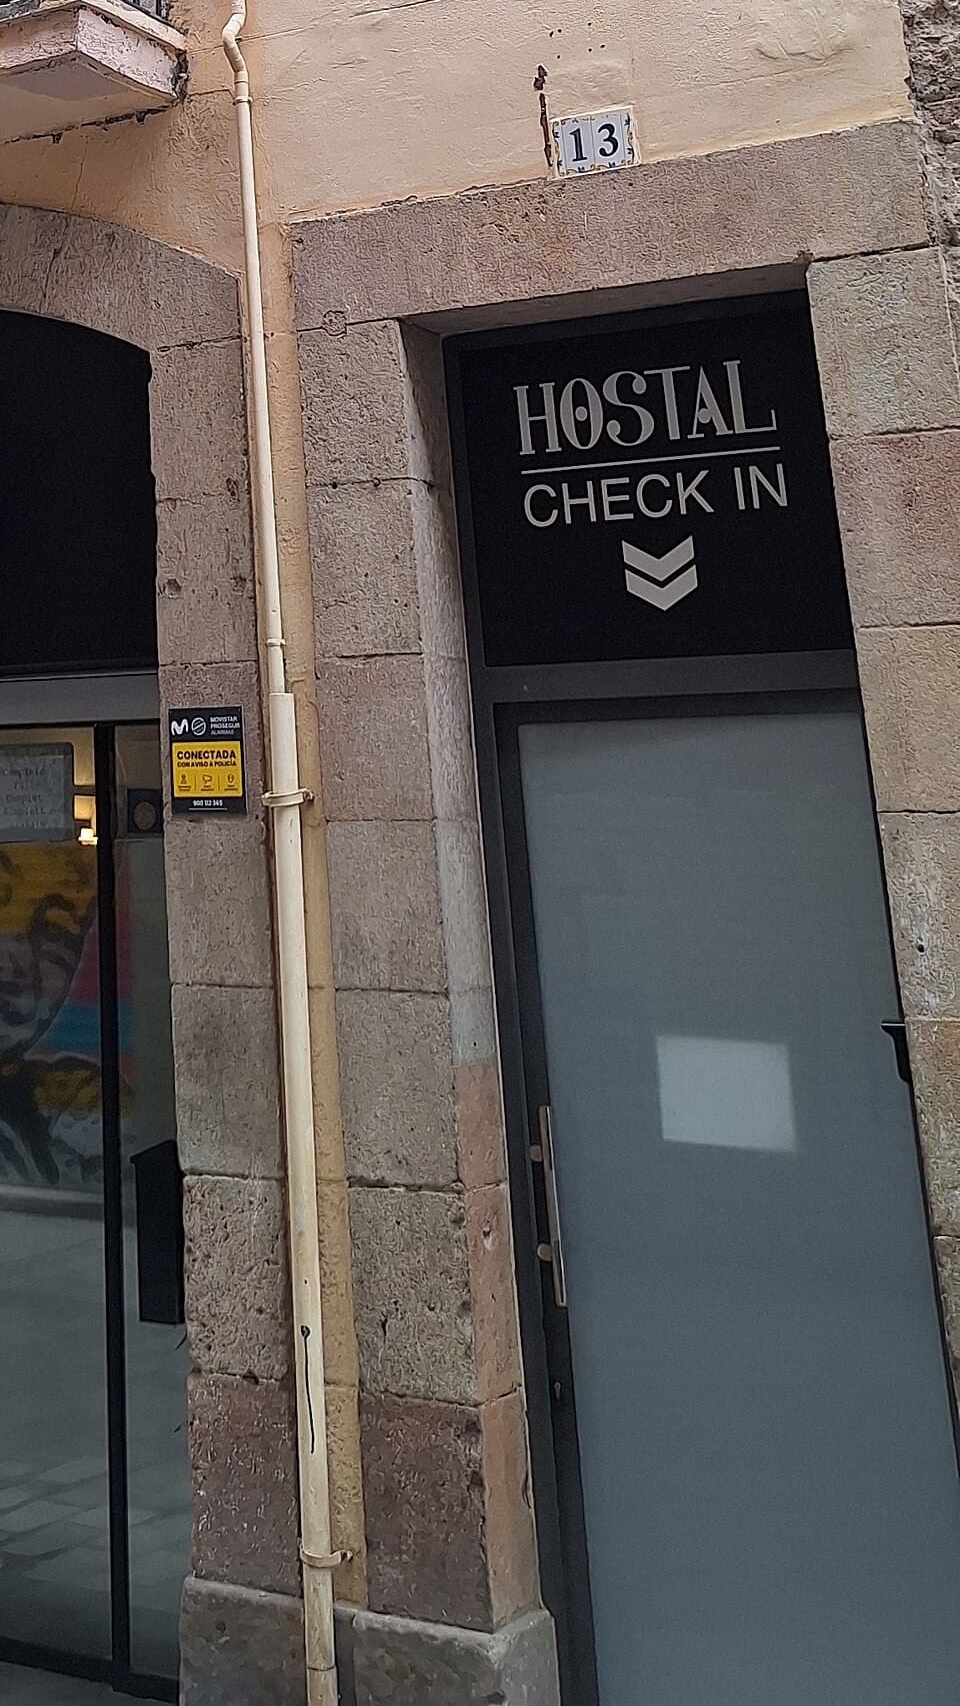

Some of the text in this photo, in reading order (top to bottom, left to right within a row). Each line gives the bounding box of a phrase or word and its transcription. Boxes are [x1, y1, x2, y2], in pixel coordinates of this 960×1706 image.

[569, 123, 619, 162] 13
[513, 360, 777, 455] HOSTAL
[523, 463, 788, 527] CHECK IN
[177, 750, 236, 760] CONECTADA
